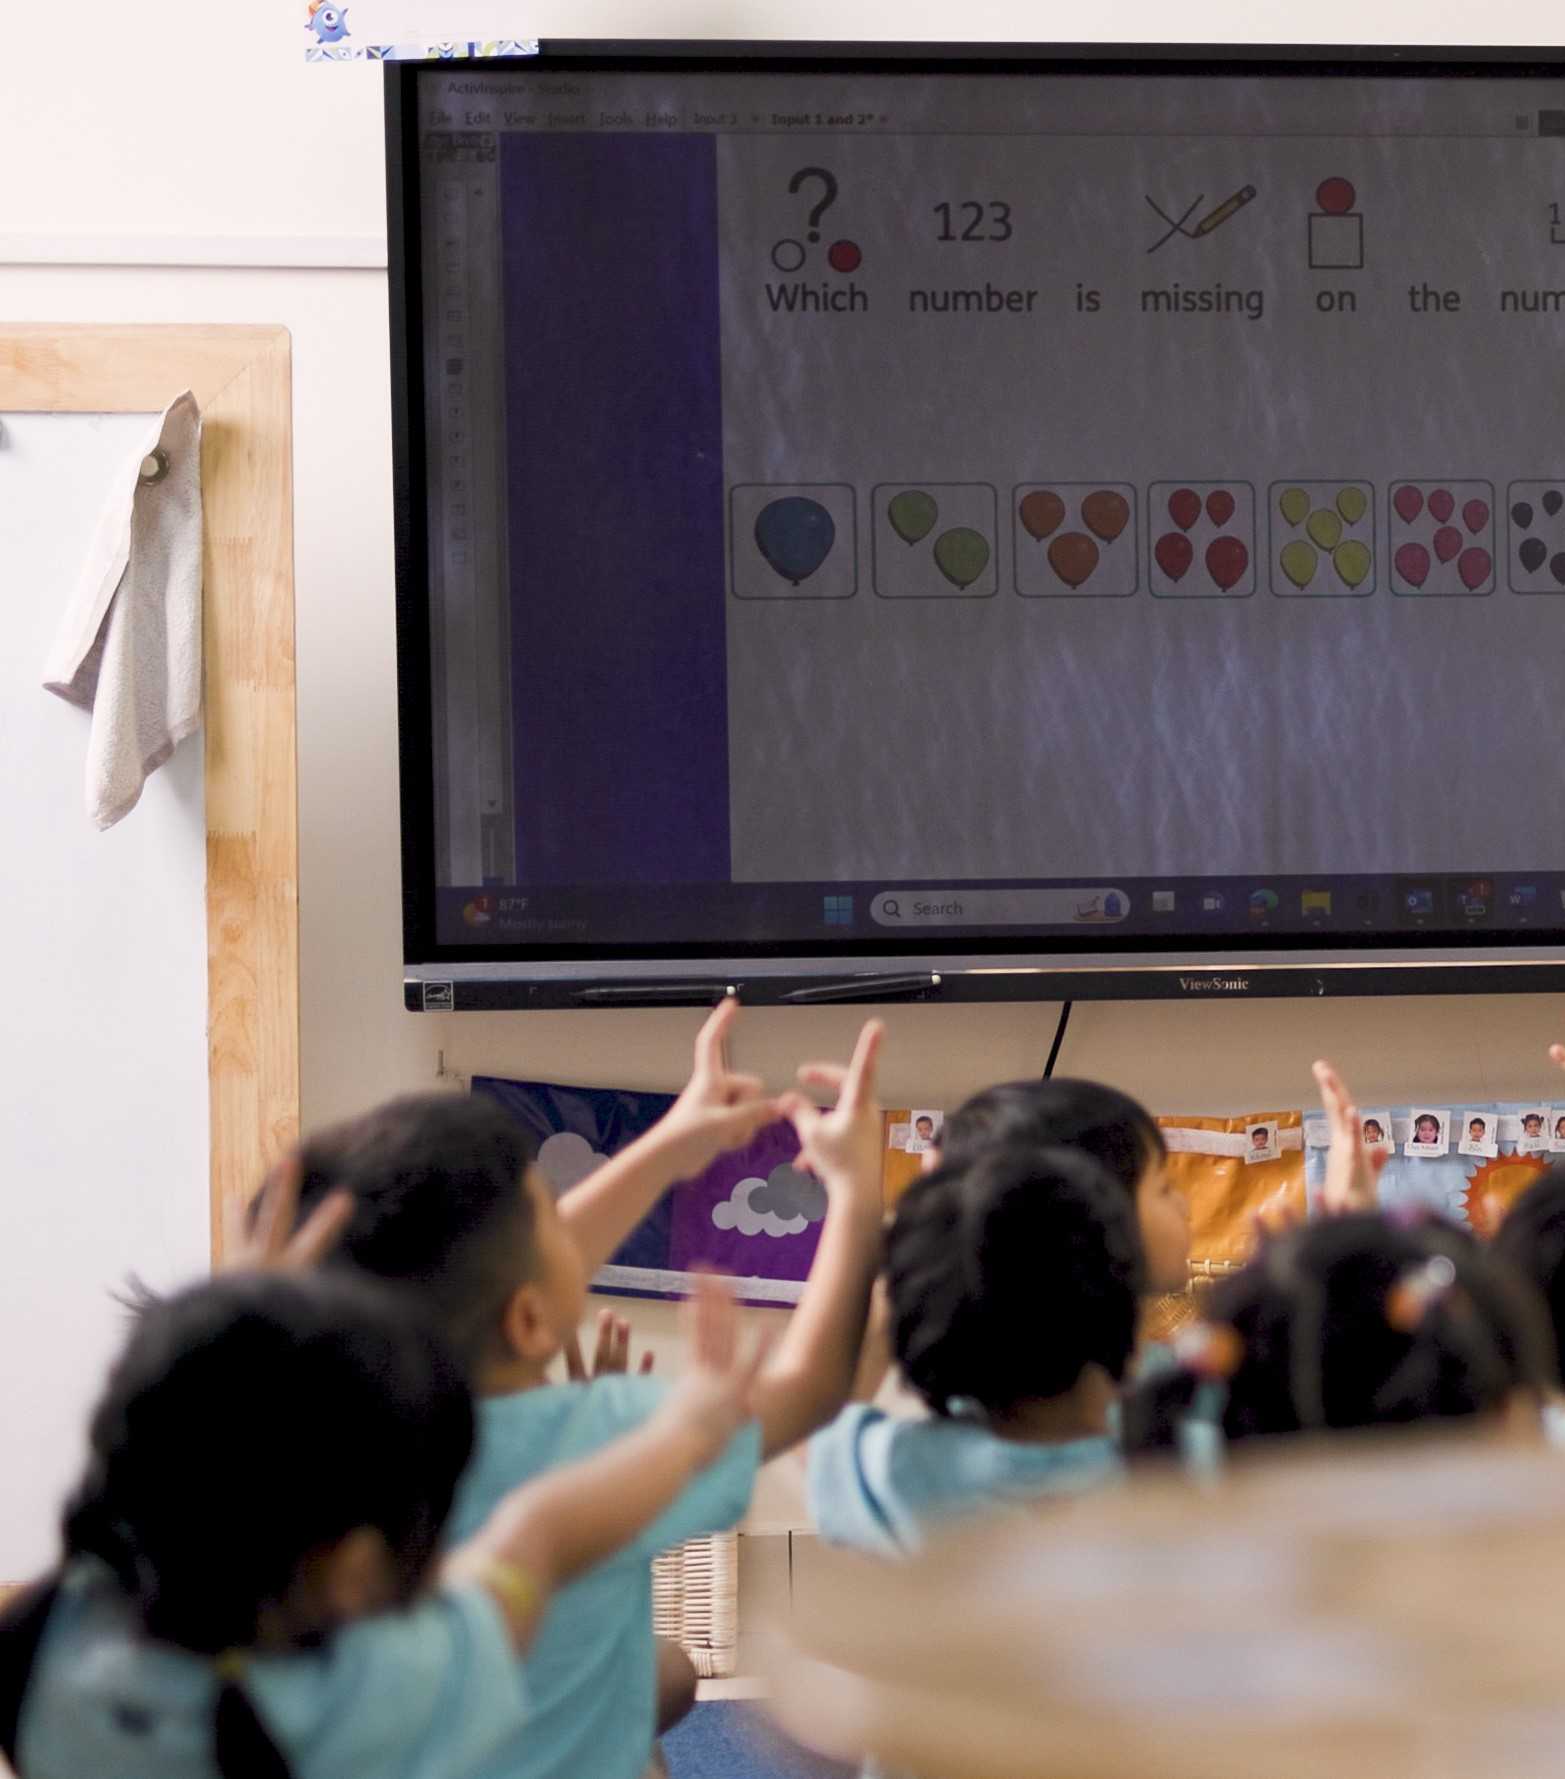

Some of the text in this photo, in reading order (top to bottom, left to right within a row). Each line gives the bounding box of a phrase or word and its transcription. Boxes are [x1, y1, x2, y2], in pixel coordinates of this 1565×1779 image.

[465, 111, 491, 125] Edit
[504, 111, 535, 125] View
[646, 112, 677, 128] Help
[771, 113, 809, 127] Input
[827, 113, 853, 125] and
[932, 201, 1013, 242] 123
[1549, 202, 1562, 225] 1
[766, 282, 868, 313] Which
[909, 282, 1038, 313] number
[1077, 282, 1101, 313] is
[1141, 282, 1264, 321] missing
[1316, 288, 1356, 313] on
[1409, 283, 1461, 313] the
[912, 899, 964, 916] Search
[1179, 977, 1249, 991] ViewSonic
